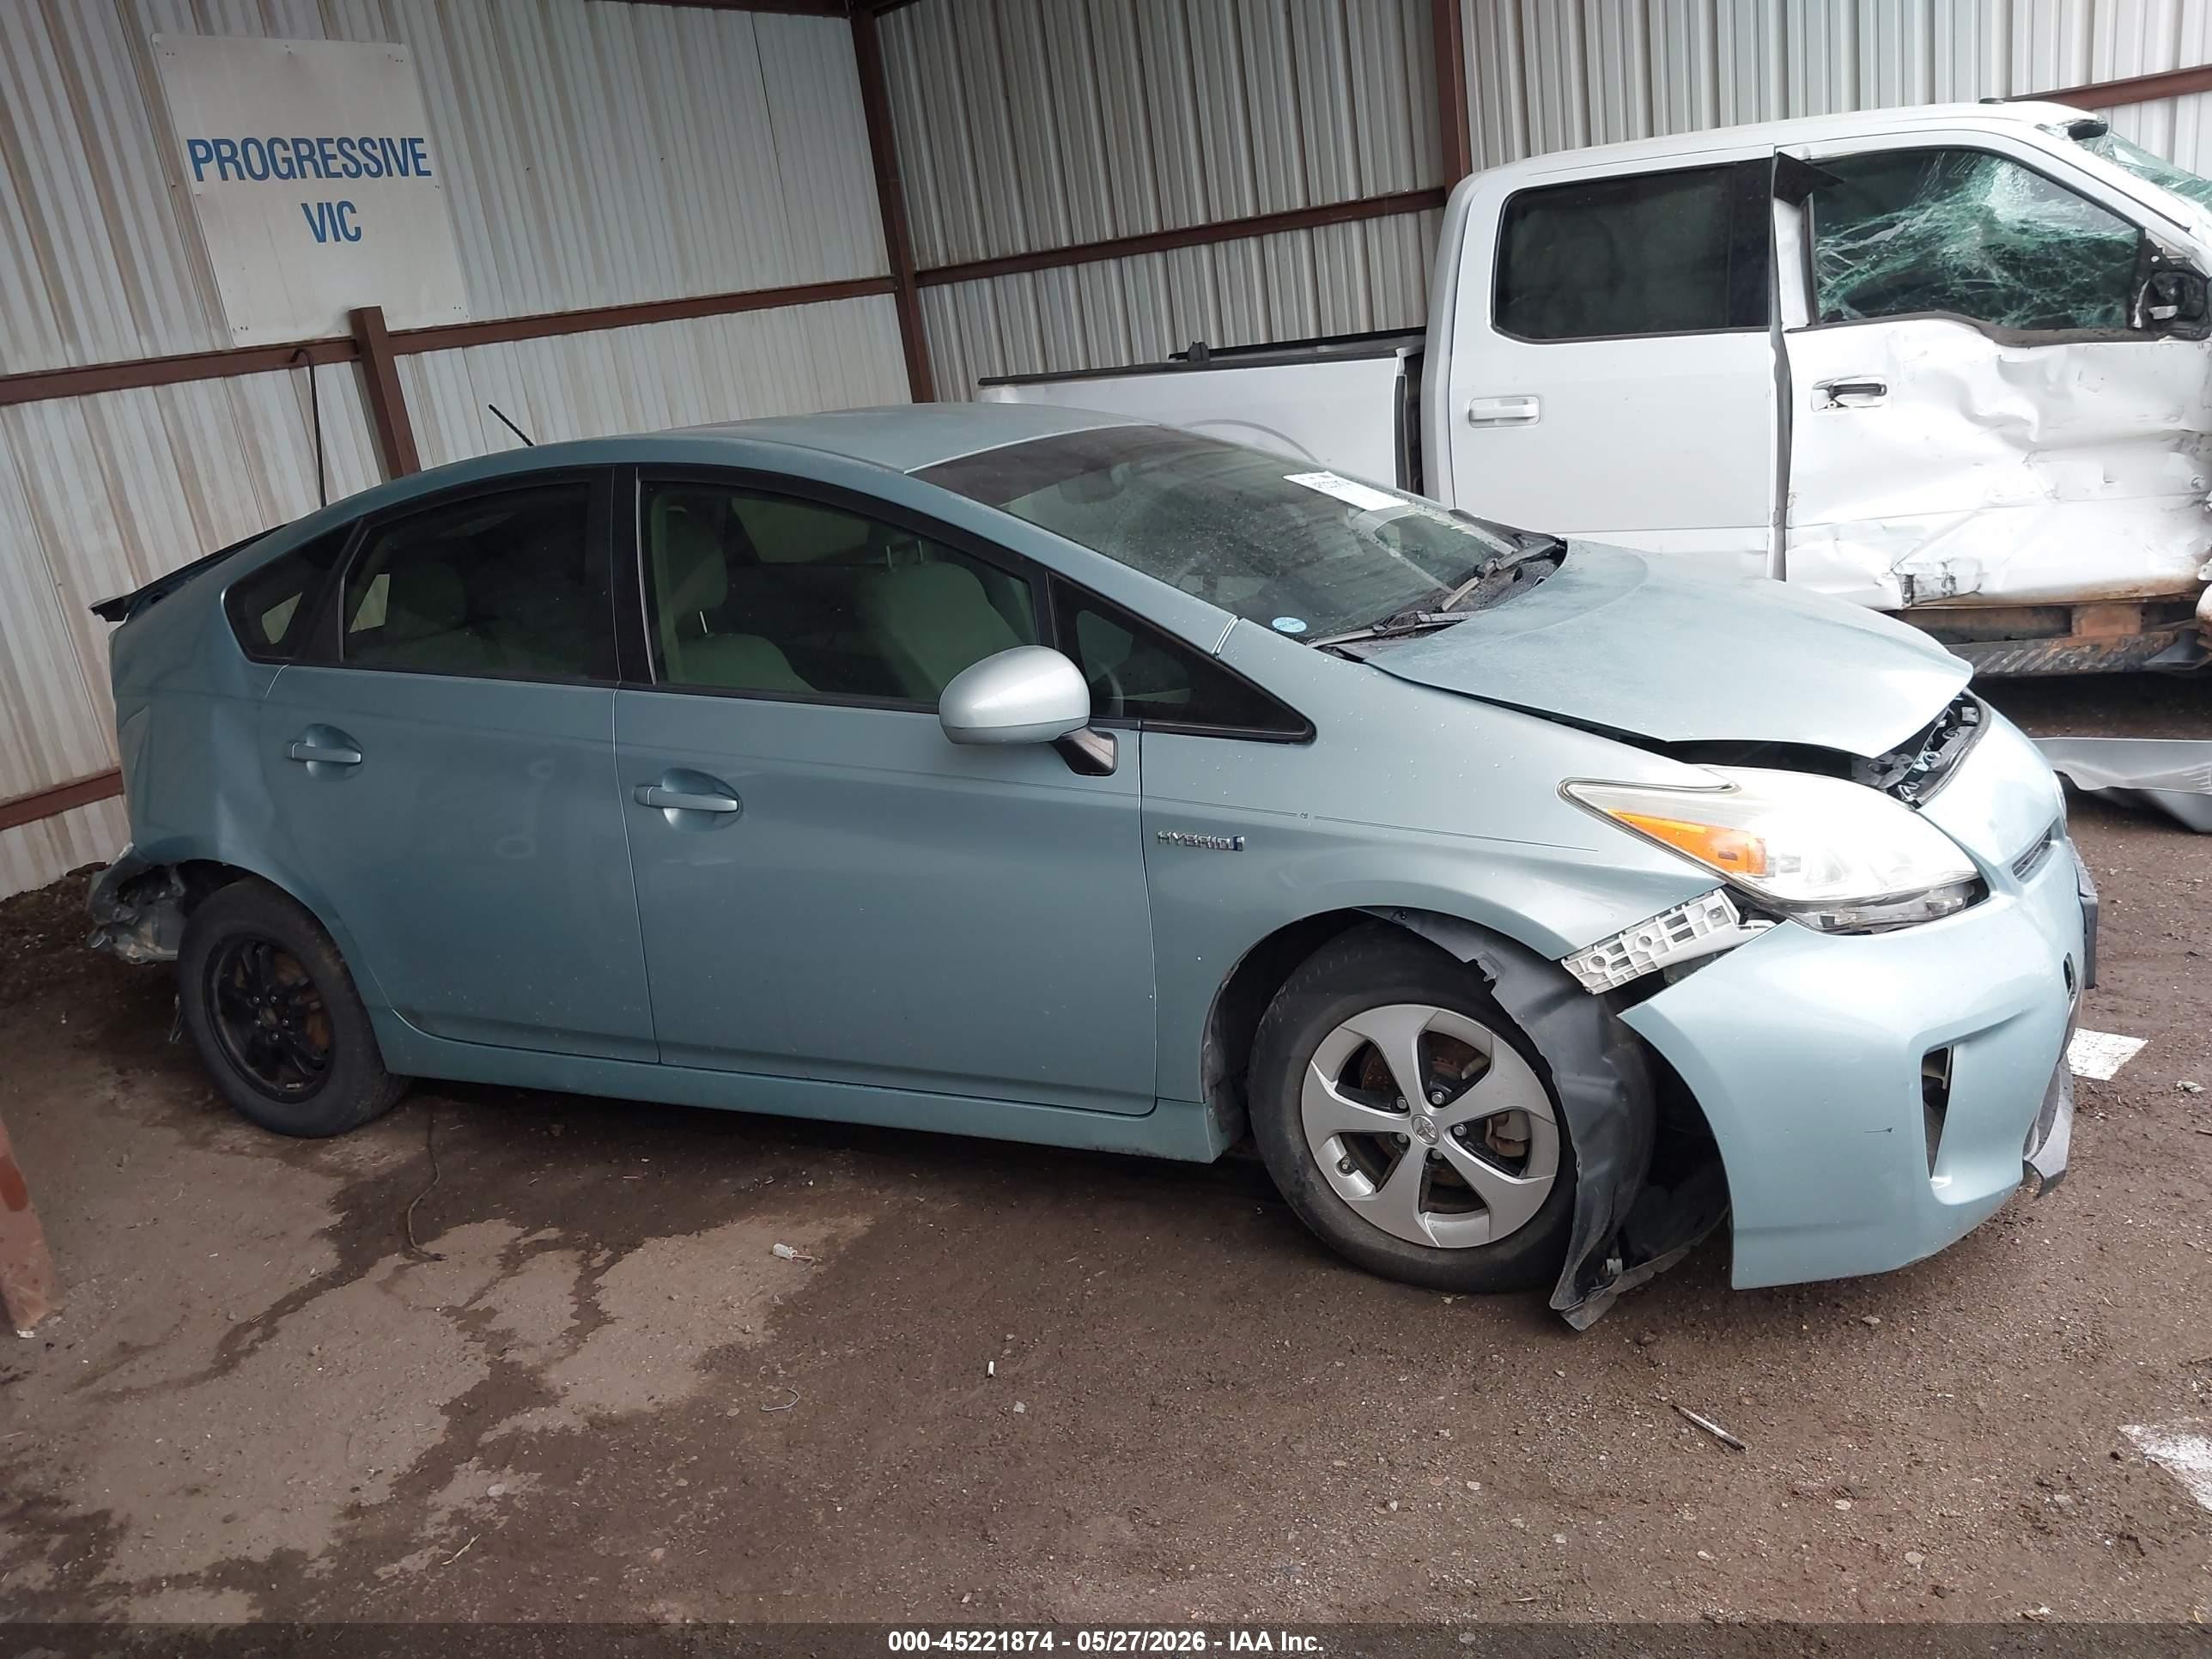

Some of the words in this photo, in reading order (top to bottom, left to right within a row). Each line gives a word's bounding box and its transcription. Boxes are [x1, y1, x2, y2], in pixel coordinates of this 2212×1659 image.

[186, 137, 433, 182] PROGRESSIVE
[301, 200, 362, 243] VIC
[1157, 830, 1232, 849] HYBRID
